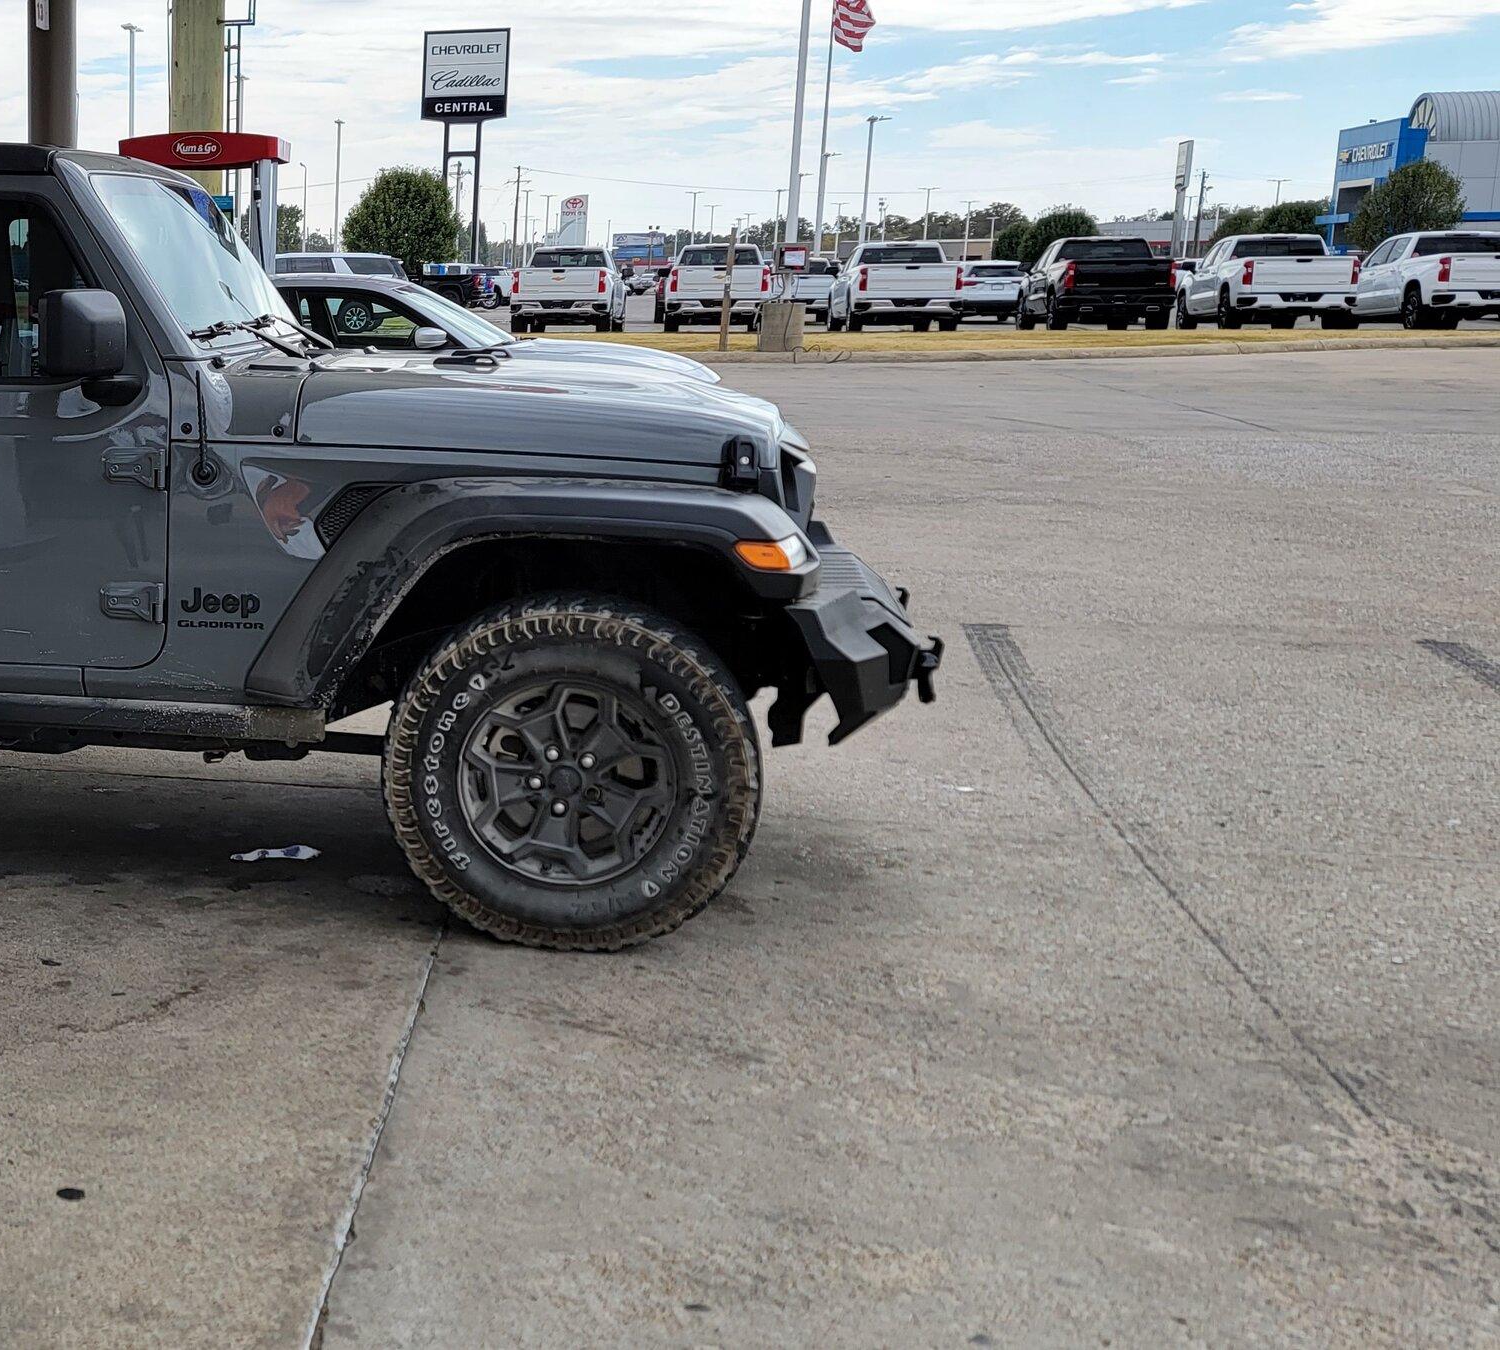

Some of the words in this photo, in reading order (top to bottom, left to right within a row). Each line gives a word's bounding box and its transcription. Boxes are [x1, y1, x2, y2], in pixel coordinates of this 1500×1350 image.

[431, 43, 502, 56] CHEVROLET
[430, 70, 501, 91] Cadillac
[434, 101, 494, 113] CENTRAL
[176, 143, 197, 153] Kum
[204, 142, 217, 153] Go
[181, 587, 260, 618] Jeep
[178, 620, 265, 630] GLADIATOR
[423, 692, 471, 871] Firestone
[659, 693, 712, 883] DESTINATION
